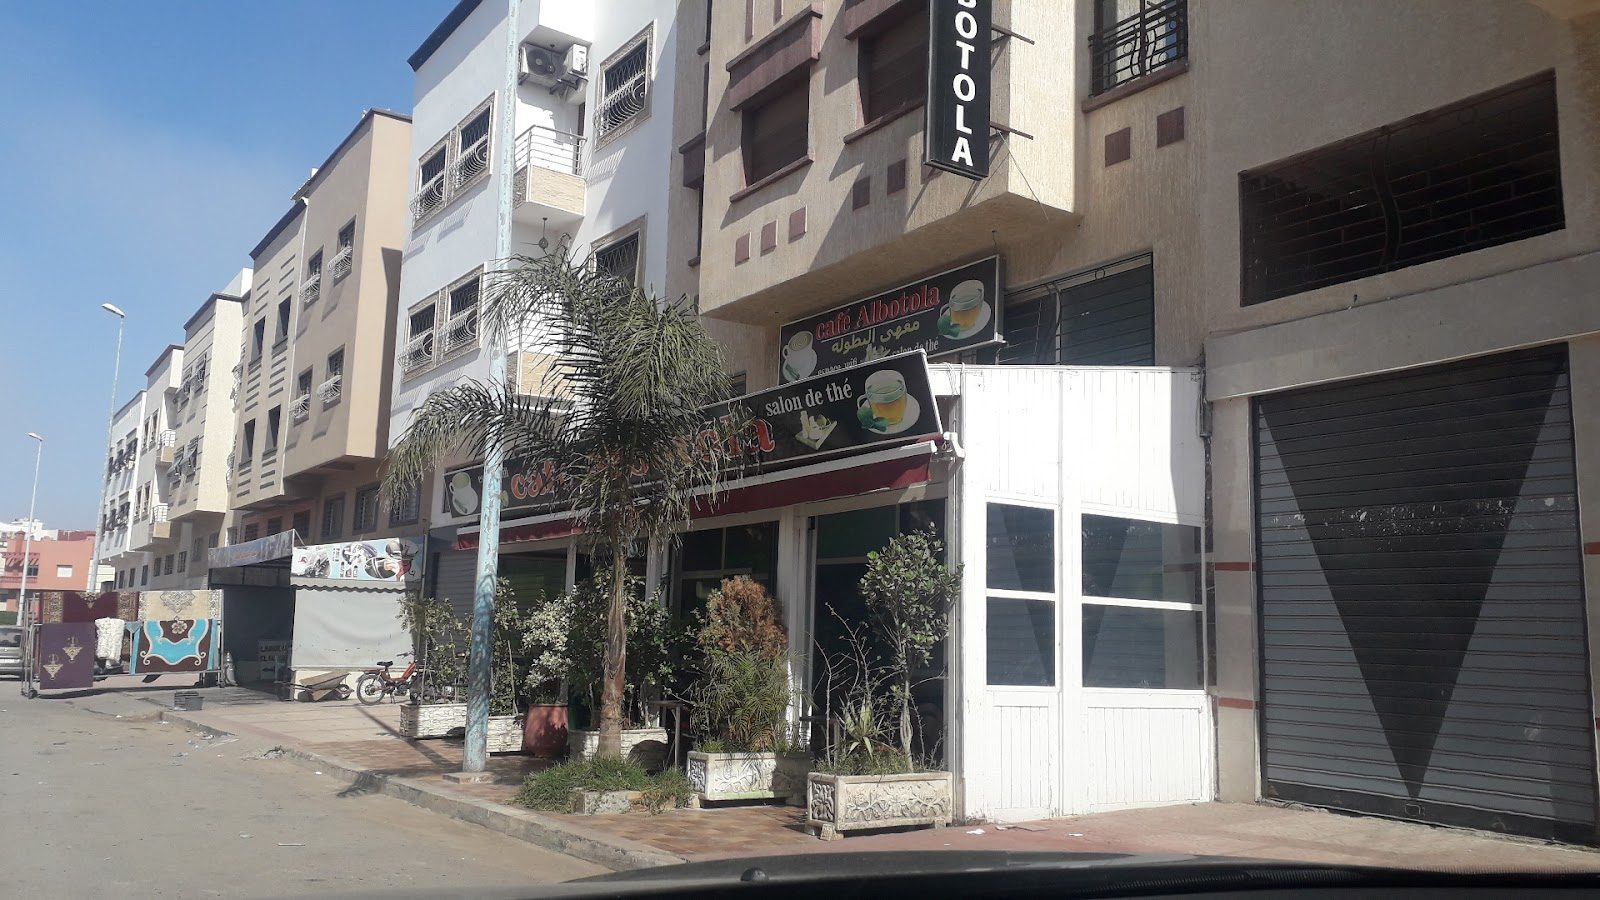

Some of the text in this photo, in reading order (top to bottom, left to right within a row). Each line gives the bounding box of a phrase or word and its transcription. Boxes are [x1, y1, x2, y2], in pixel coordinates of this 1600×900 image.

[857, 284, 940, 328] Albotola
[925, 336, 939, 352] thé
[765, 377, 853, 417] salon de thé
